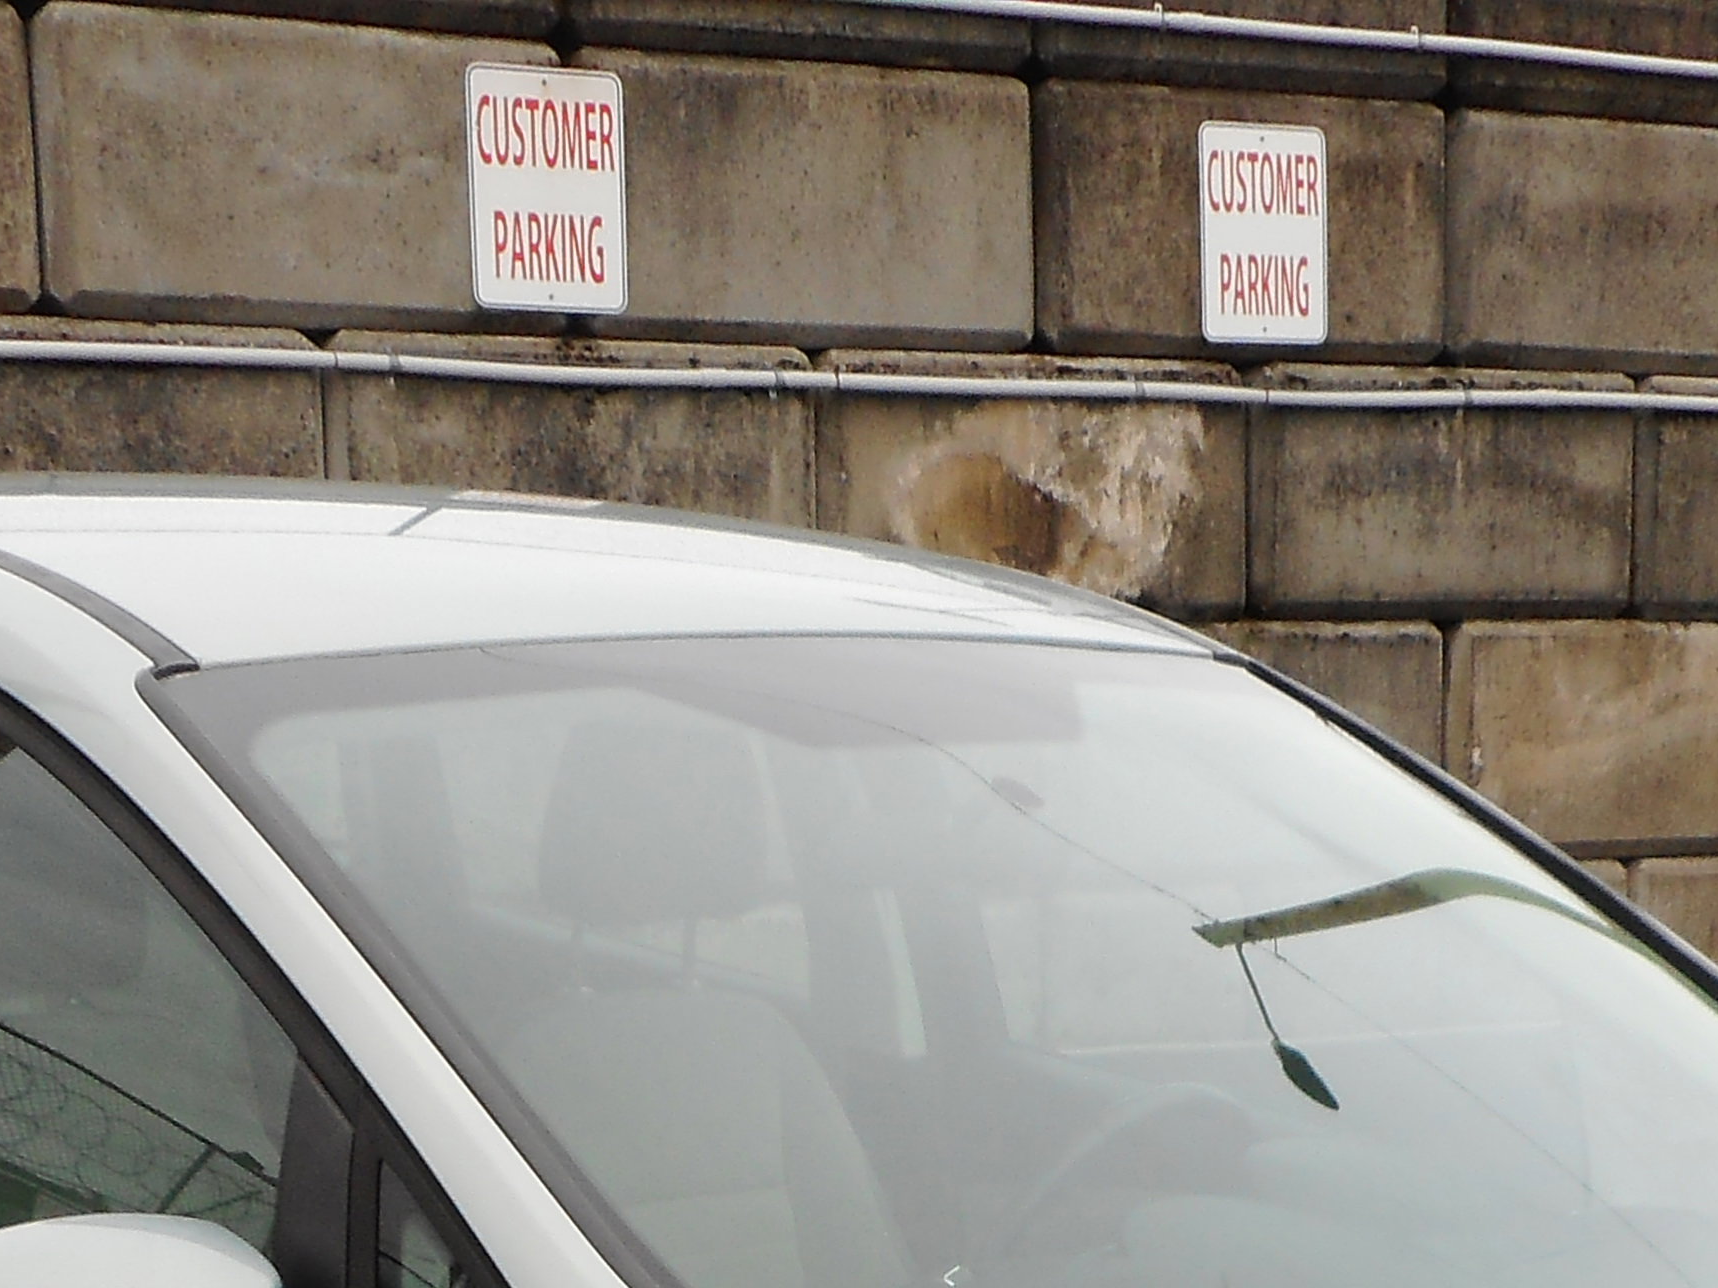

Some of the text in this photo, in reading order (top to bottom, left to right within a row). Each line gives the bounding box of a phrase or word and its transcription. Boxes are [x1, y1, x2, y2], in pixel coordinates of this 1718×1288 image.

[476, 94, 615, 172] CUSTOMER
[1207, 149, 1319, 217] CUSTOMER
[493, 210, 605, 284] PARKING
[1220, 253, 1309, 318] PARKING
